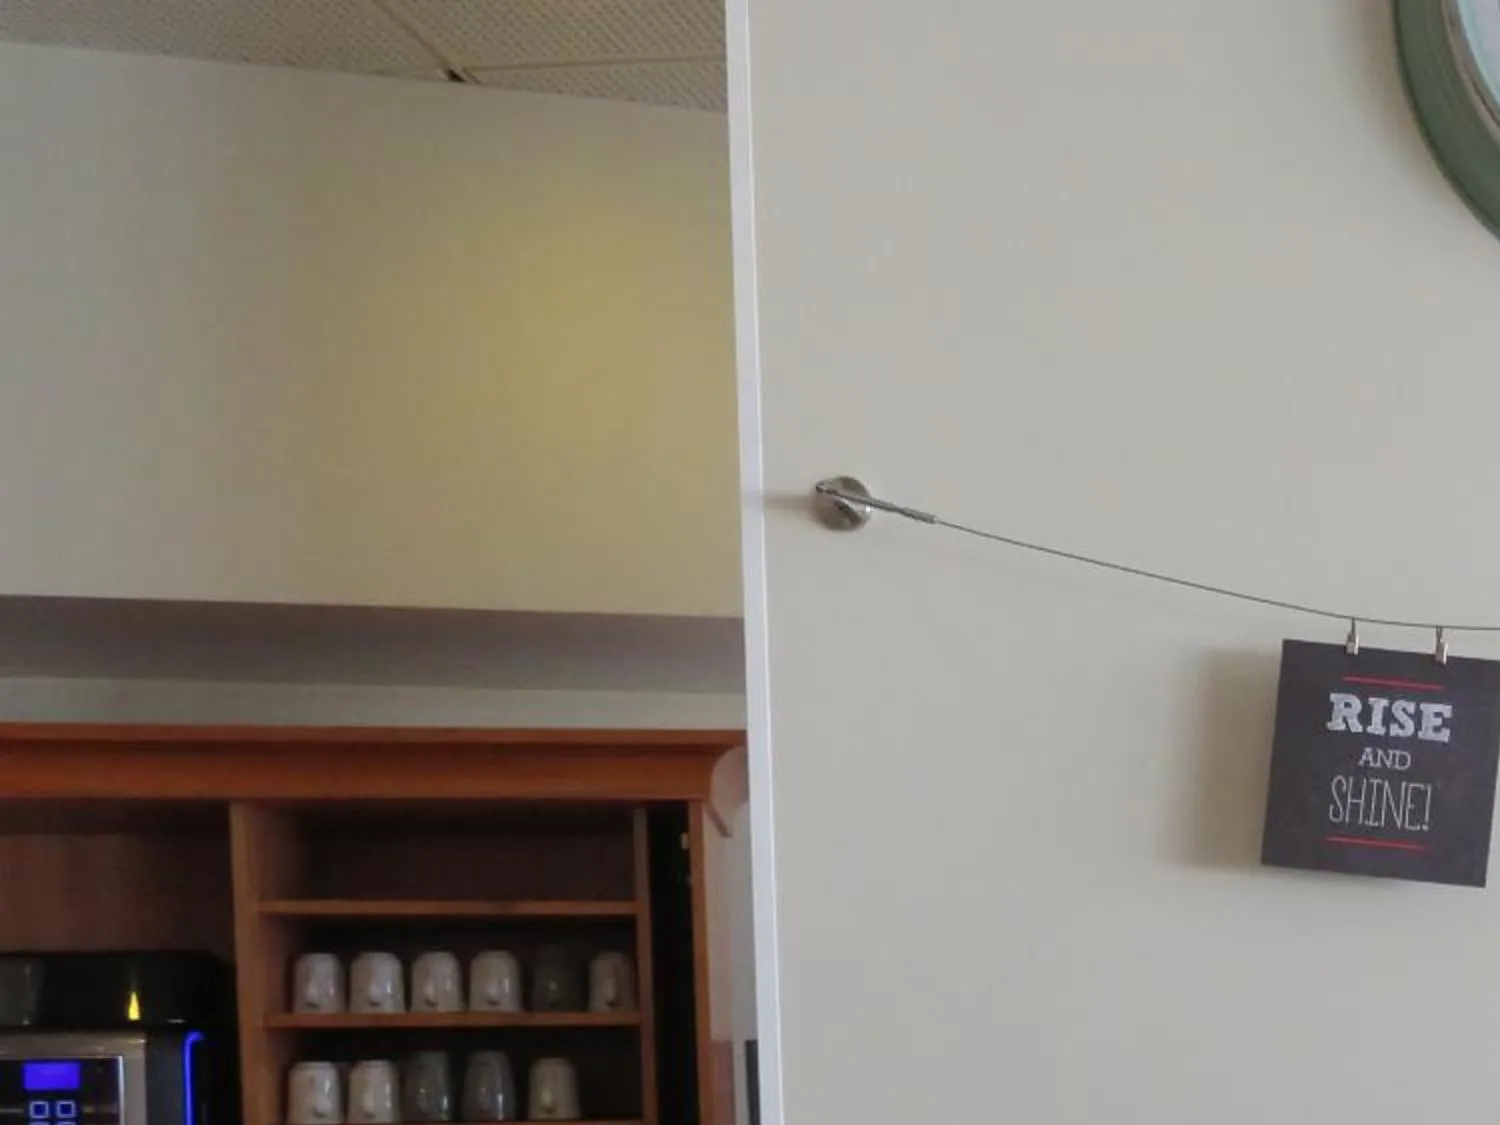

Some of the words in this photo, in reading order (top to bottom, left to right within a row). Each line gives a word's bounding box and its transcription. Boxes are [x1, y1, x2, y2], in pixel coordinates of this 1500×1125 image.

[1326, 692, 1453, 743] RISE
[1358, 747, 1411, 771] AND
[1328, 775, 1433, 832] SHINE!
